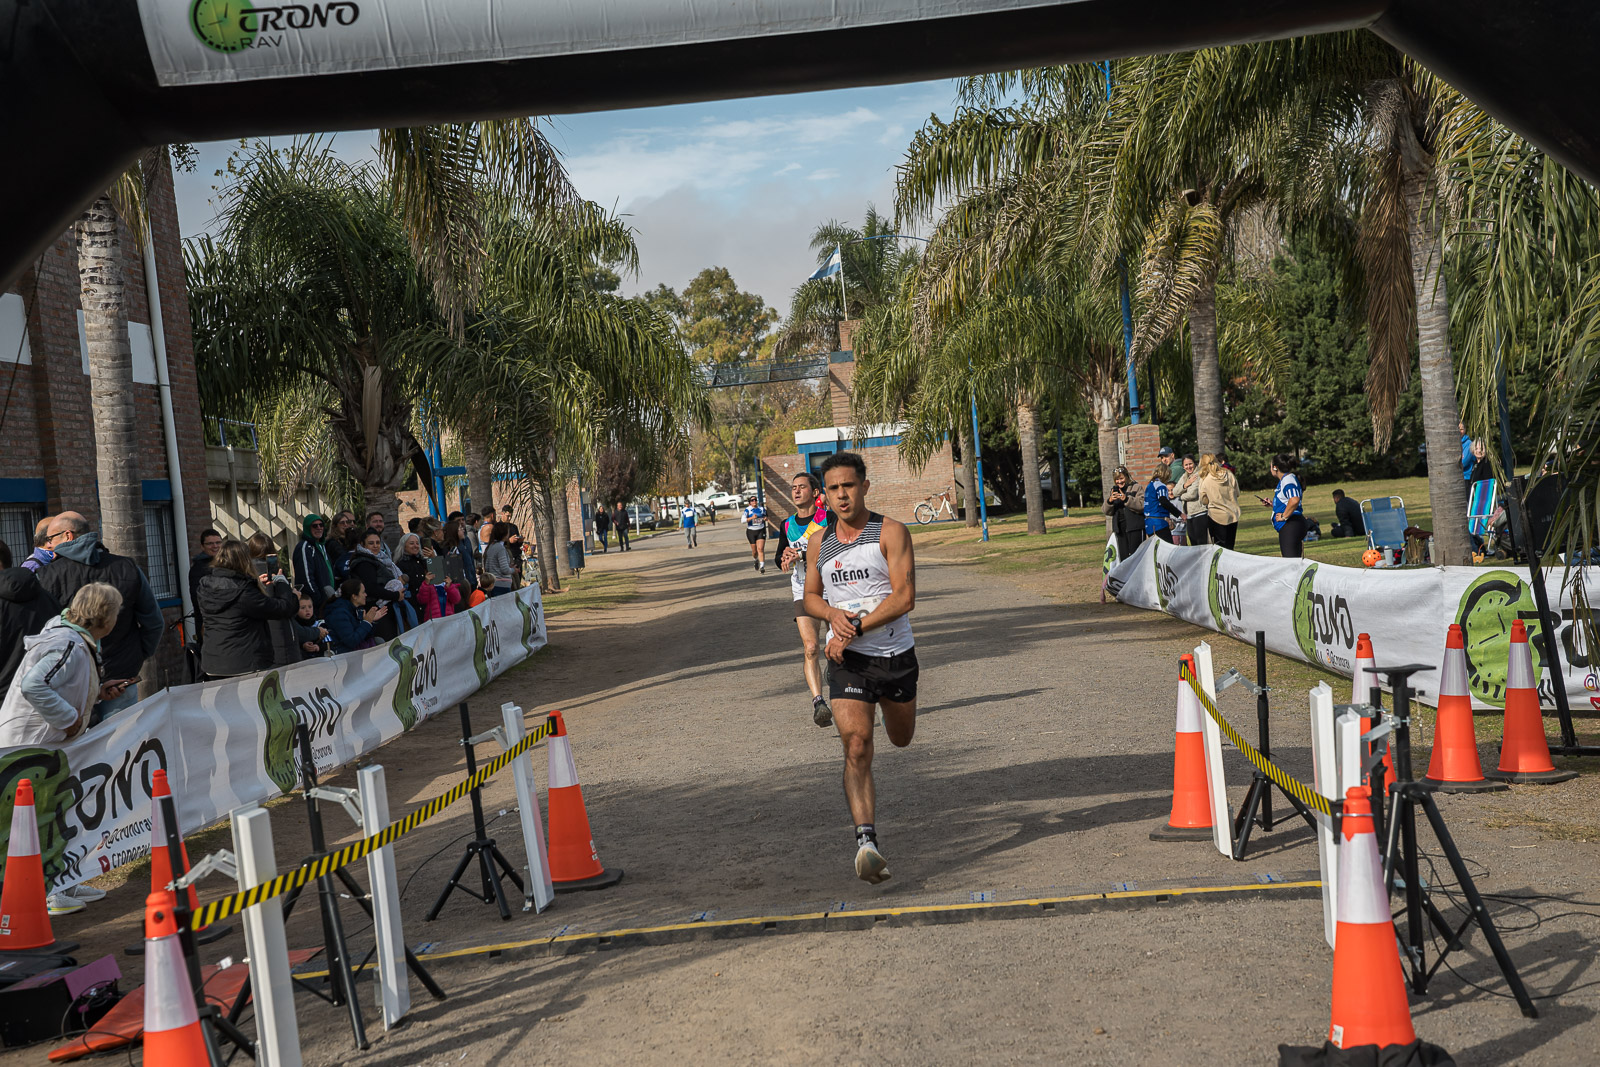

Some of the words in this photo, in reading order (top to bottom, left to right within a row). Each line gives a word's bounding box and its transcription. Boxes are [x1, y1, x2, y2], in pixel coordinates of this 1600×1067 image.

[239, 2, 360, 32] CRONO
[240, 35, 283, 49] RAV
[831, 568, 870, 583] ATENAS
[105, 816, 152, 849] @cronora
